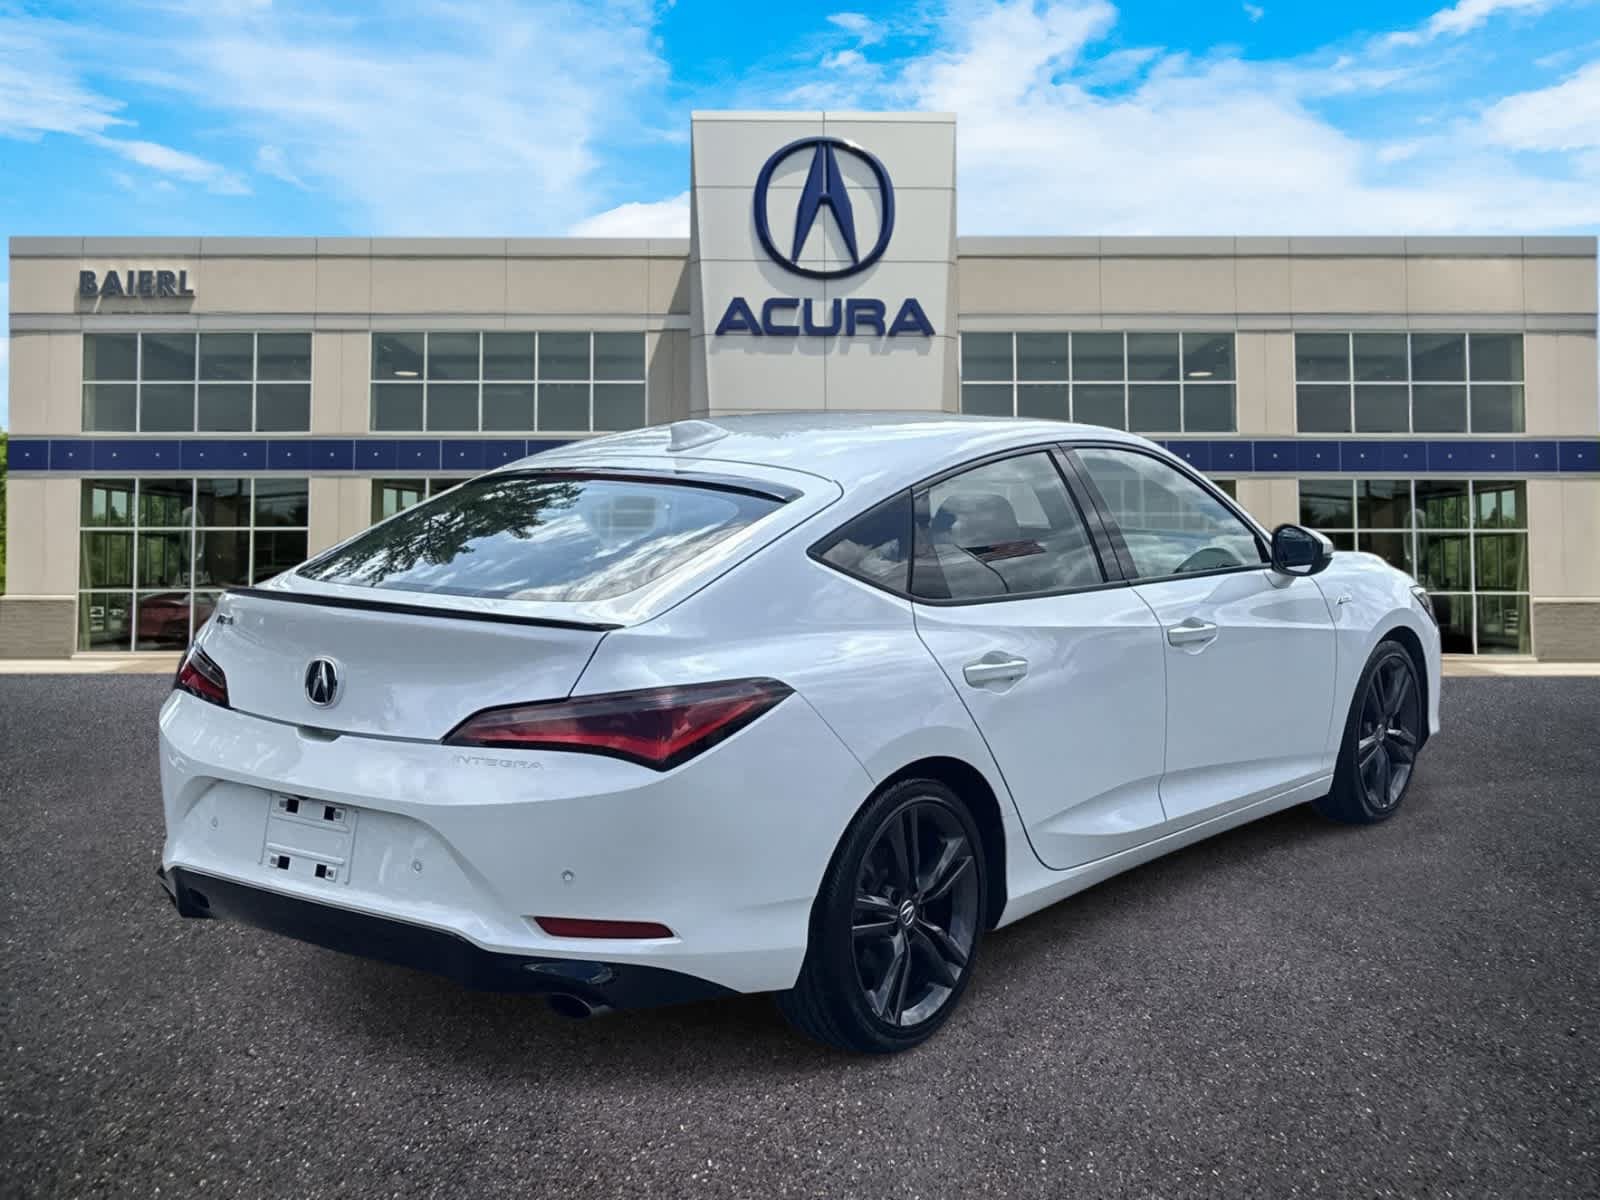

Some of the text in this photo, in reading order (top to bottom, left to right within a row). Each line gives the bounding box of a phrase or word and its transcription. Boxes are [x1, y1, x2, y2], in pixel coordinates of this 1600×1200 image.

[79, 270, 195, 297] BAIERL
[715, 297, 936, 337] ACURA
[453, 754, 545, 770] INTEGRA
